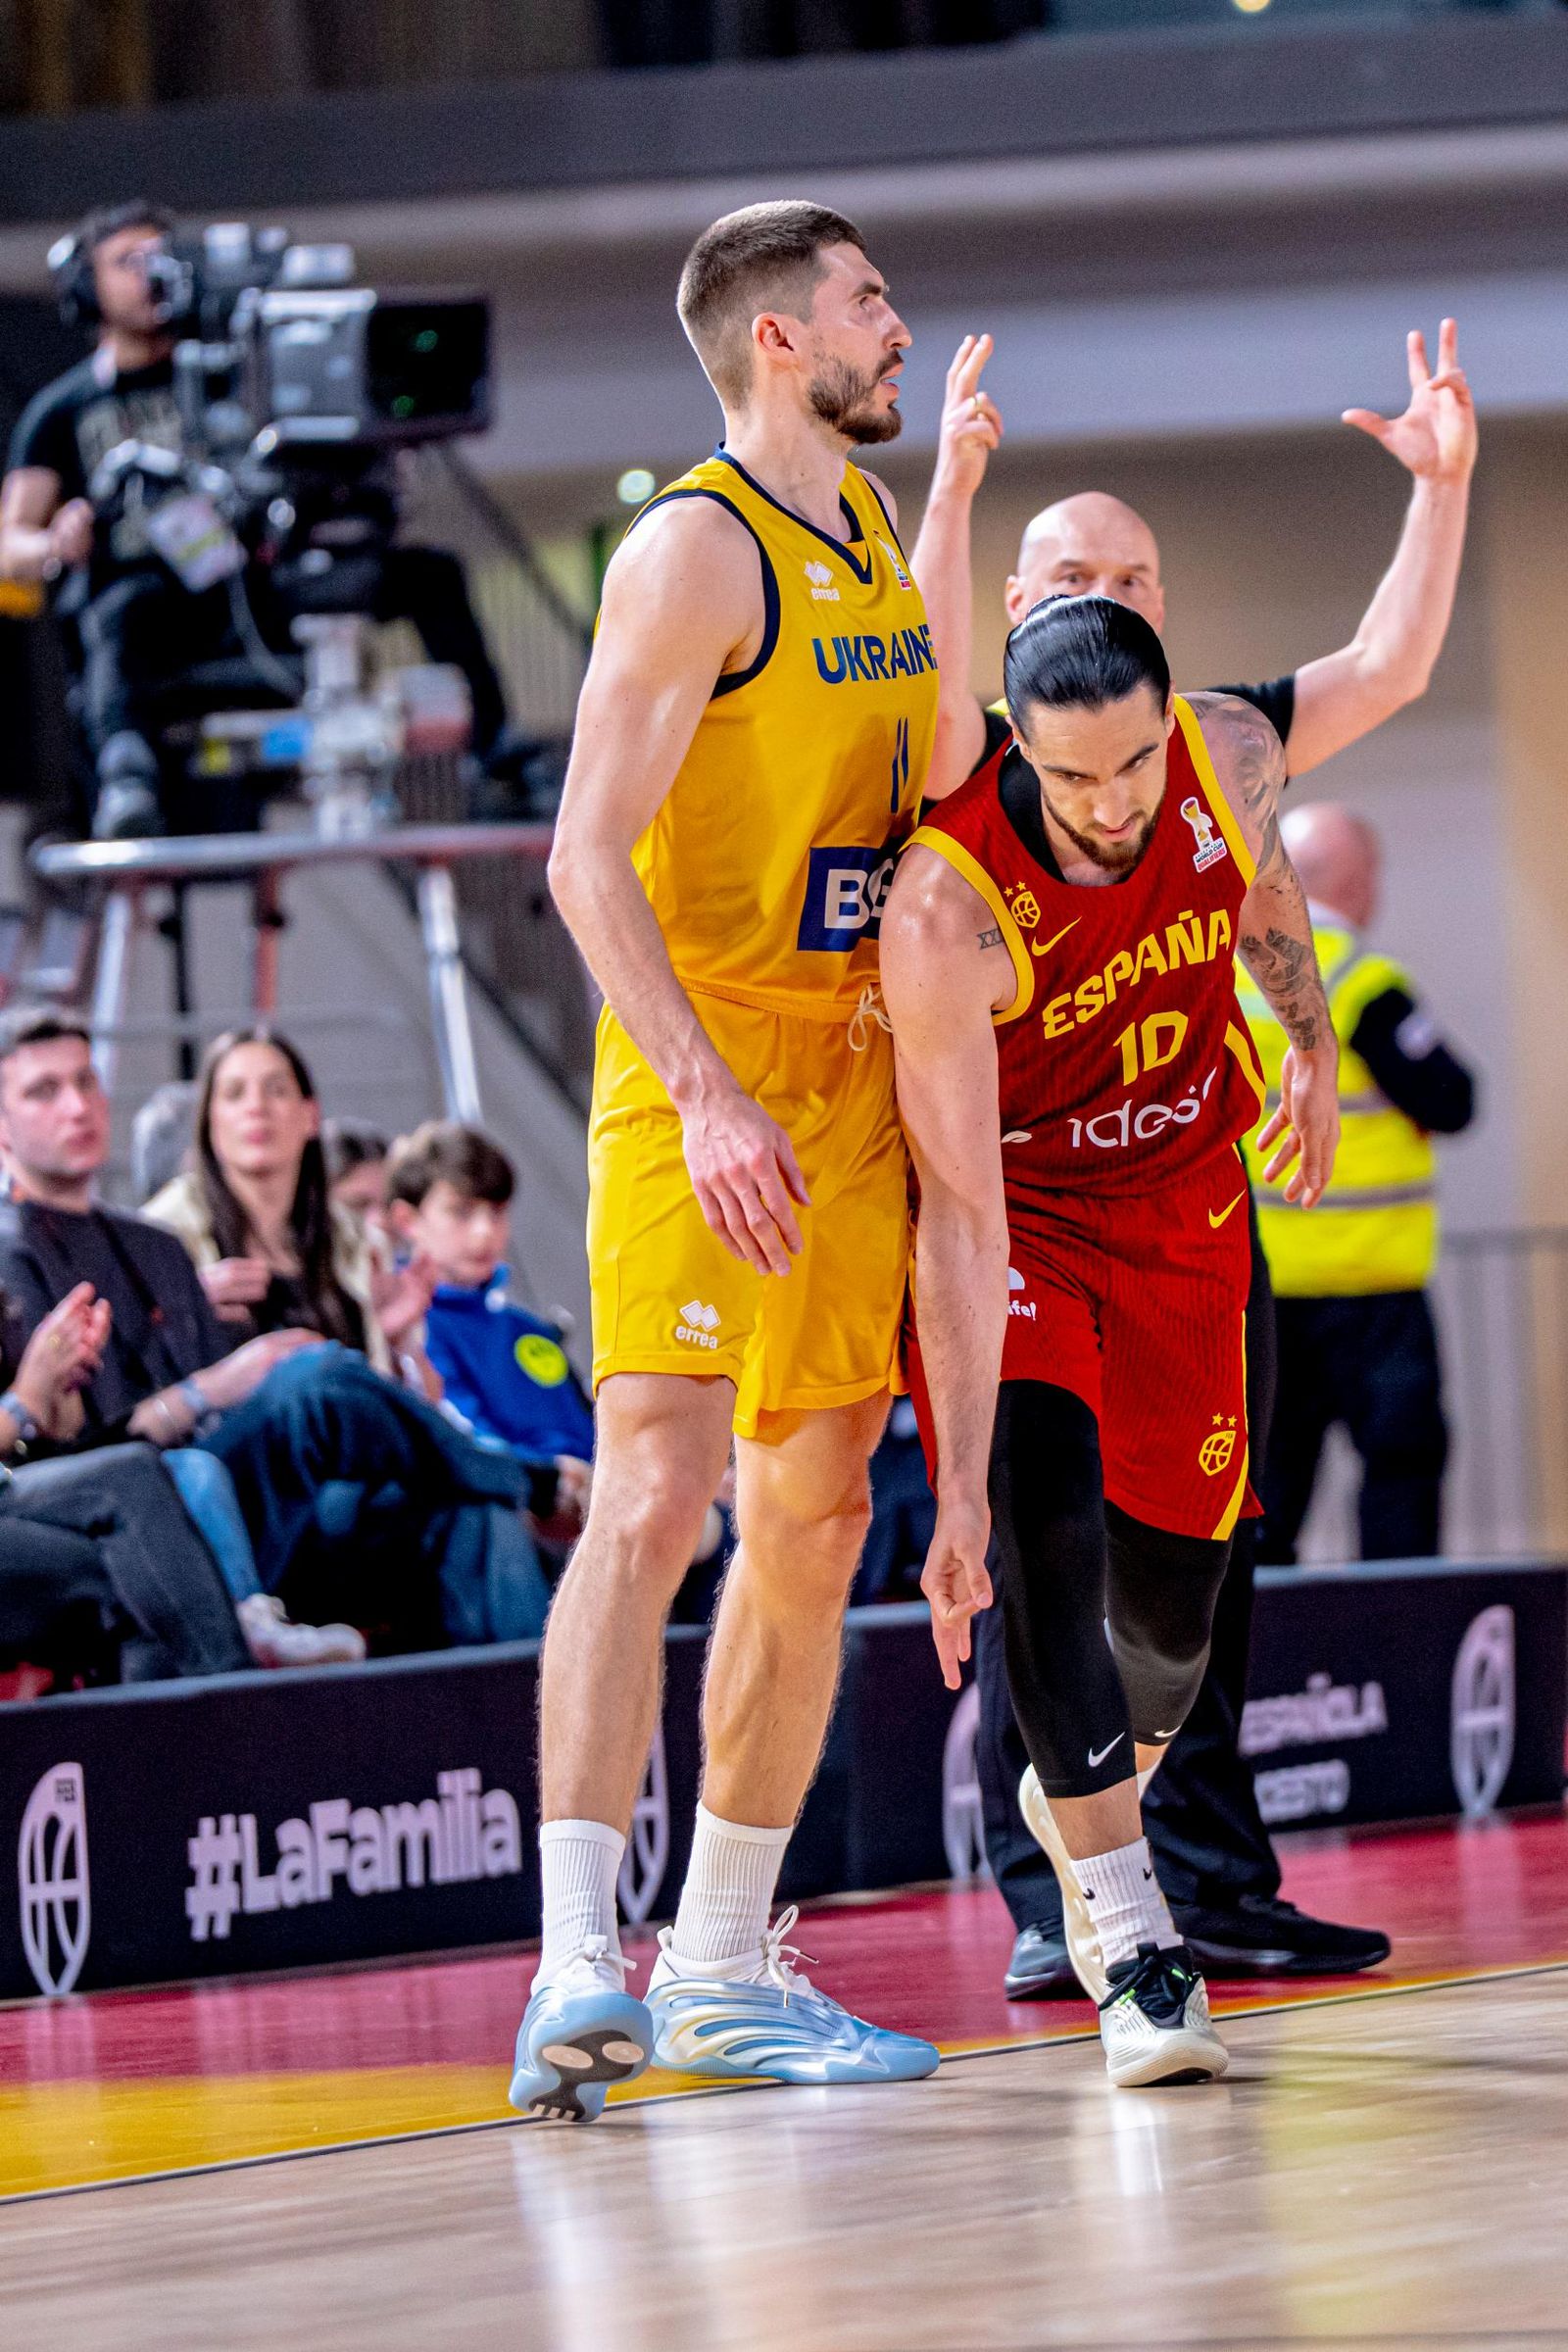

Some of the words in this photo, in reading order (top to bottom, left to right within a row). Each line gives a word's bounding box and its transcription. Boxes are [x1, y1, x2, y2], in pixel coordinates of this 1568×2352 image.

[1196, 848, 1214, 862] WORLD
[1041, 908, 1233, 1040] ESPAÑA
[1112, 1009, 1189, 1087] 10
[675, 1325, 719, 1349] errea
[184, 1767, 522, 1941] #LaFamilia
